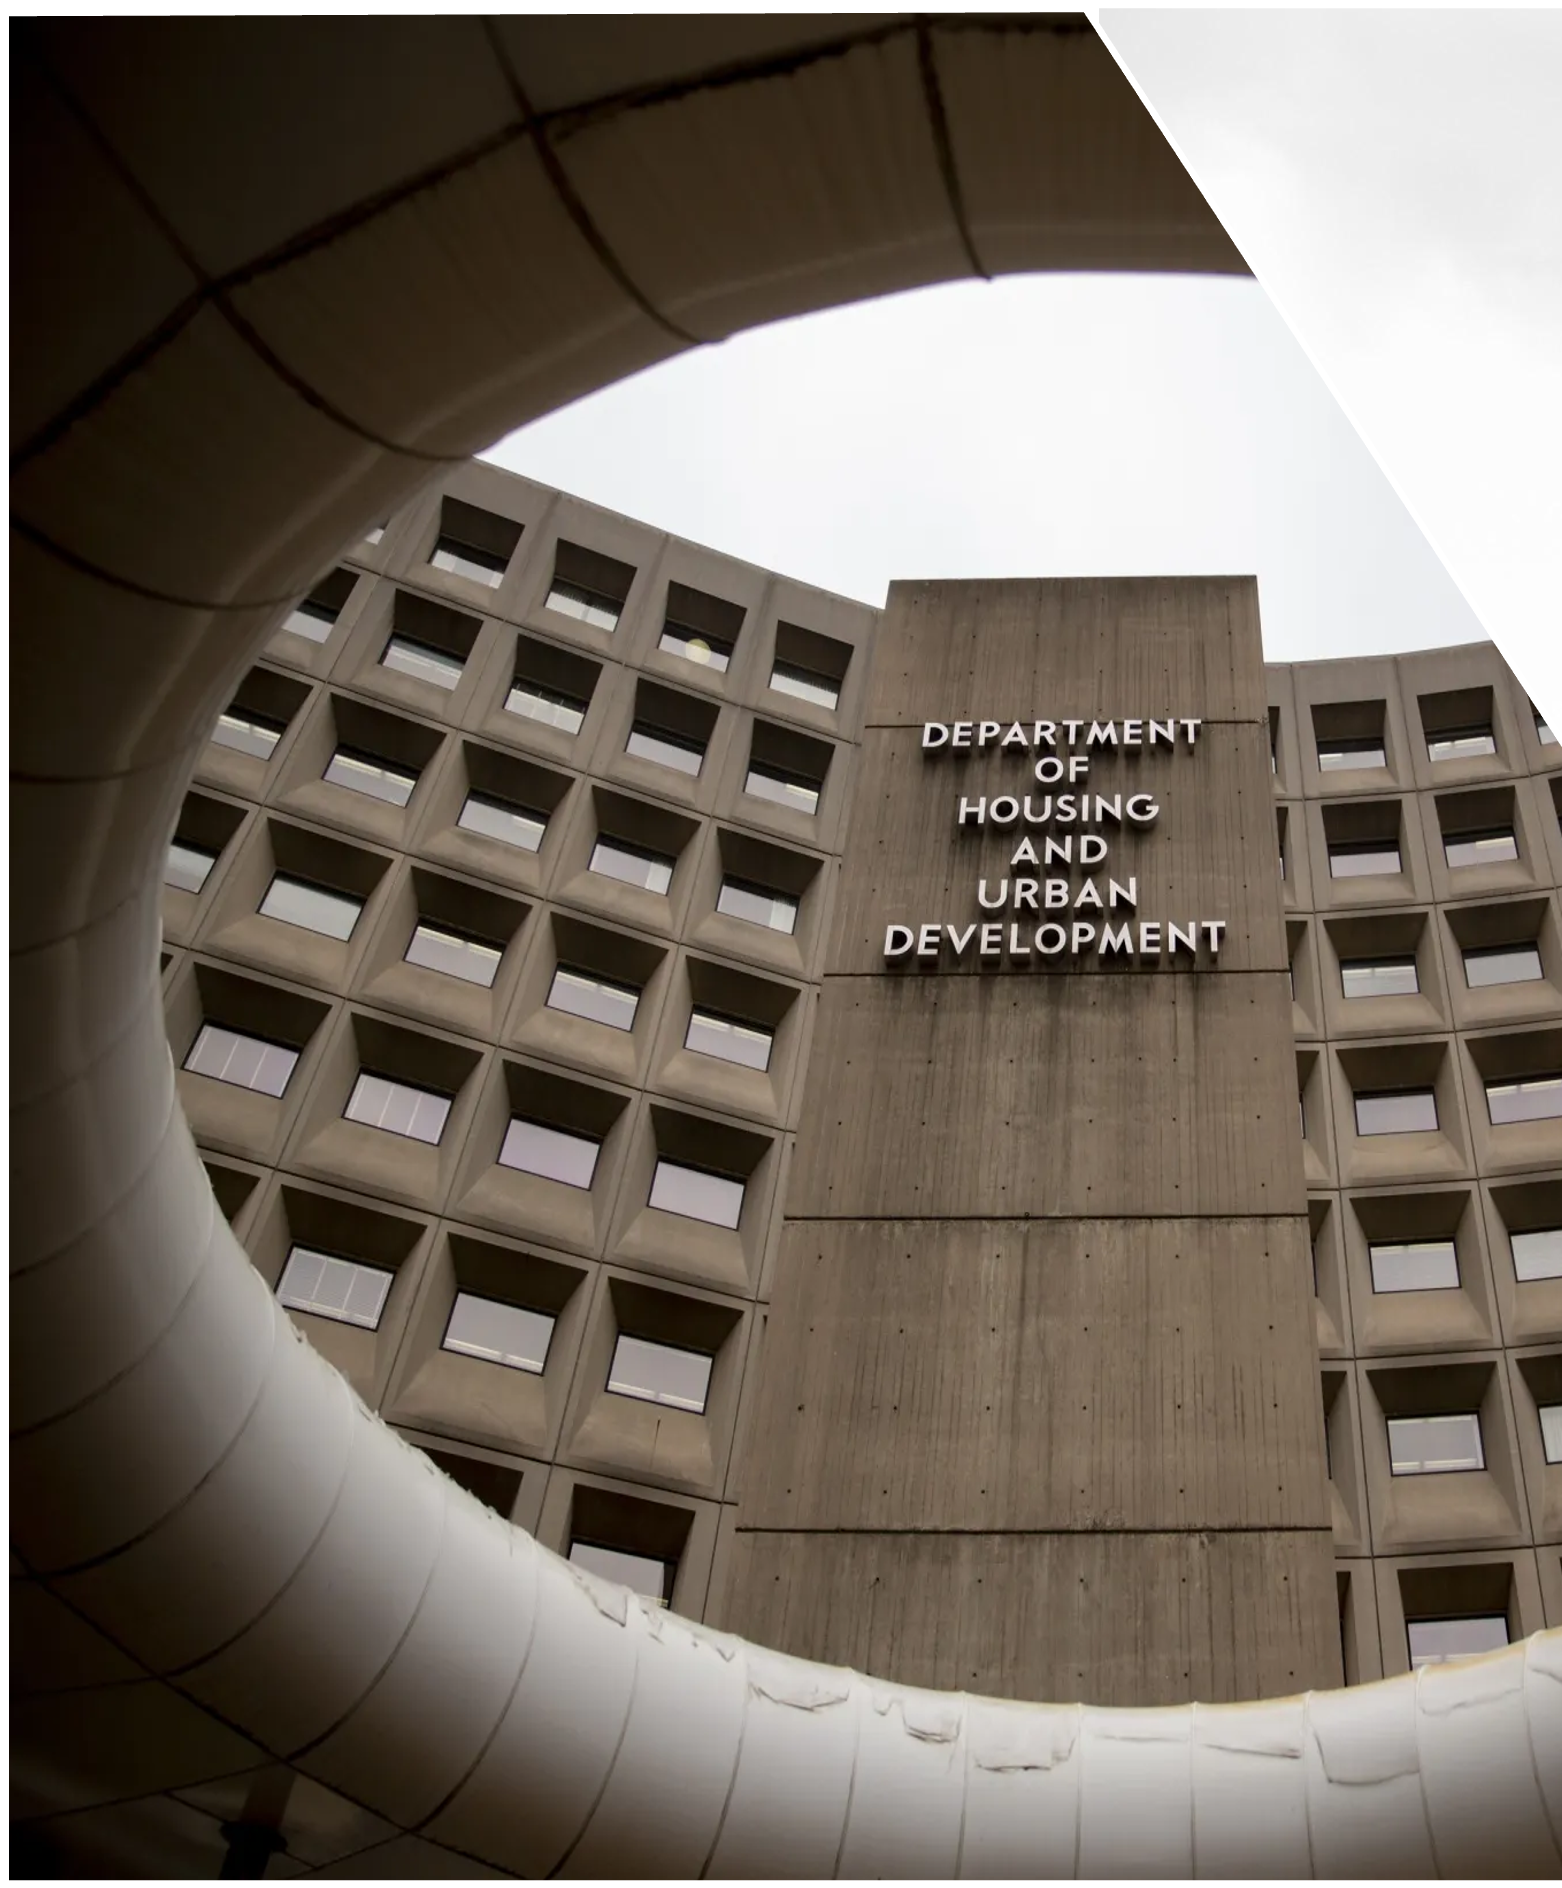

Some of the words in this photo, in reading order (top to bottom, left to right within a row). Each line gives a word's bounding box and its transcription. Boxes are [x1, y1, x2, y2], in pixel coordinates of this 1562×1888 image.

[921, 718, 1202, 748] DEPARTMENT
[1034, 756, 1089, 783] OF
[958, 794, 1160, 824] HOUSING
[1010, 835, 1108, 865] AND
[977, 877, 1137, 909] URBAN
[883, 920, 1227, 956] DEVELOPMENT
